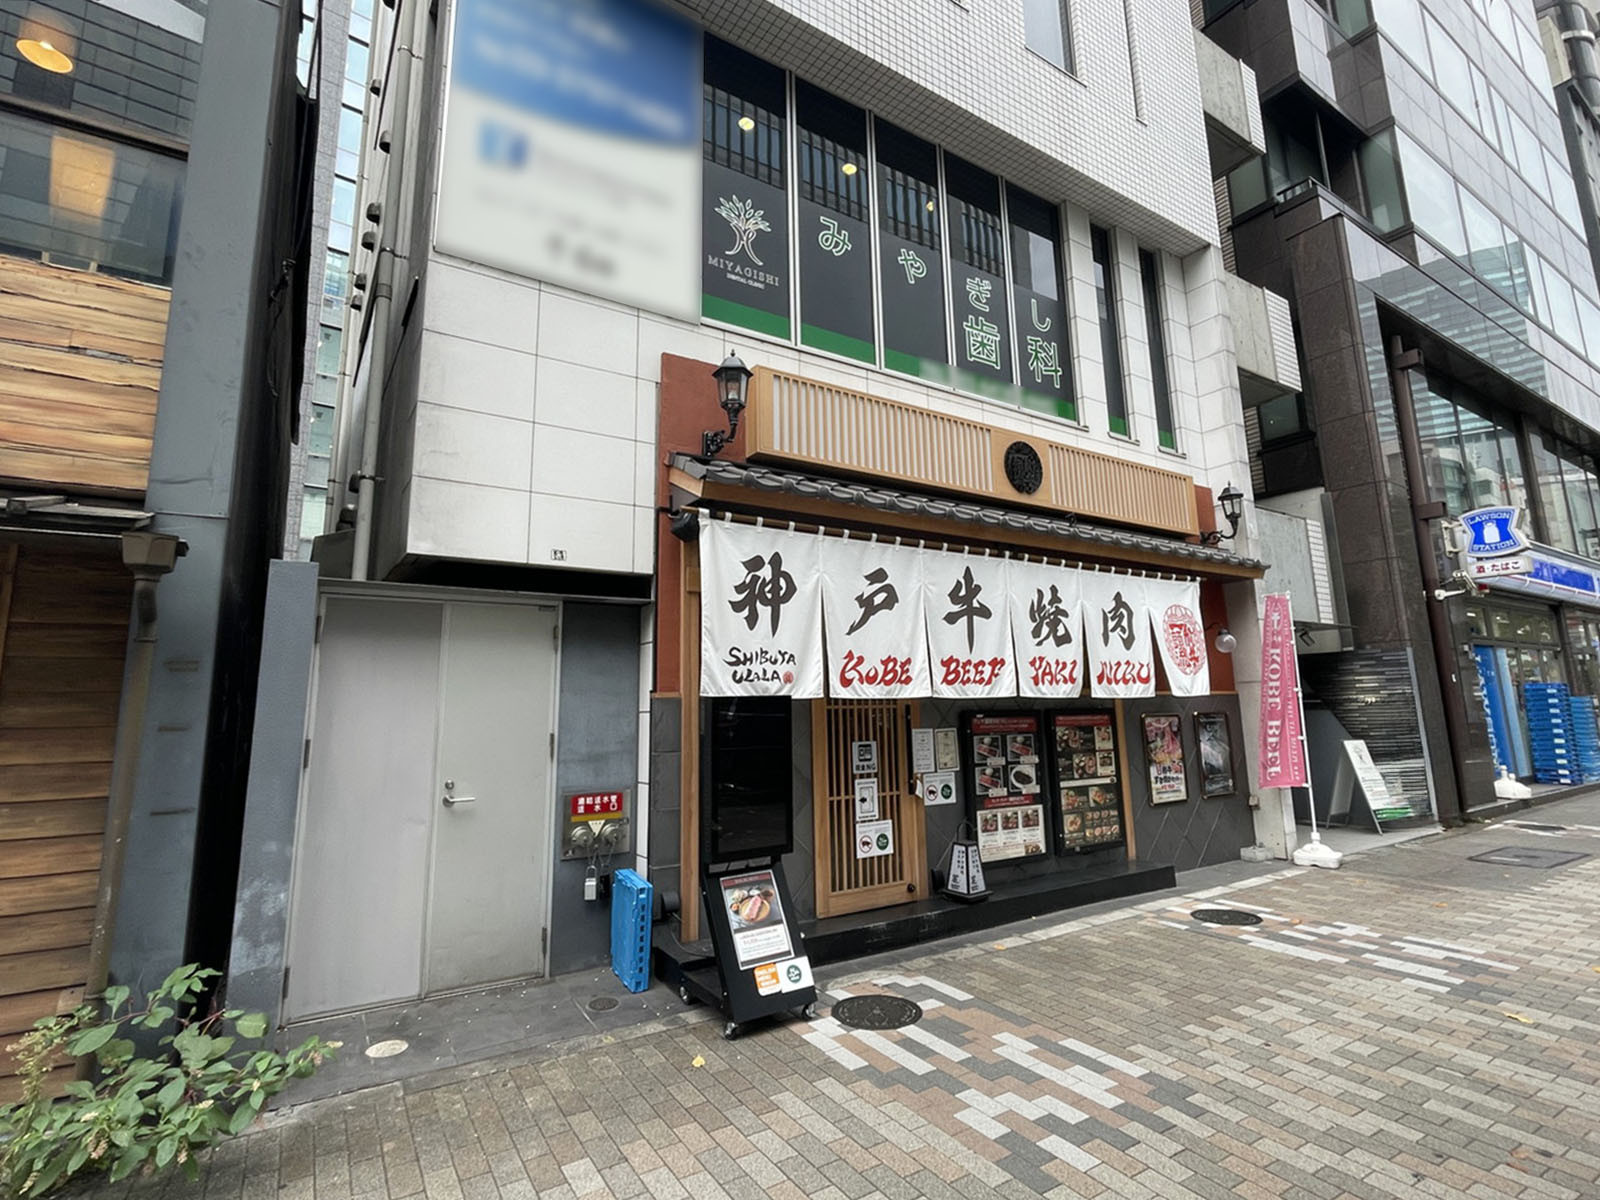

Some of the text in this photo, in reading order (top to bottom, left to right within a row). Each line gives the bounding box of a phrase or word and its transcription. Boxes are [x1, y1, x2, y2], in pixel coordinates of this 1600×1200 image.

[707, 254, 780, 287] MIYAGISHI
[1467, 511, 1511, 525] LAWSON
[1472, 538, 1515, 552] STATION
[722, 646, 798, 668] SHIBUYA
[839, 649, 914, 689] KOBE
[939, 654, 1006, 688] BEEF
[1027, 655, 1080, 688] YAKI
[1266, 648, 1282, 711] KOBE
